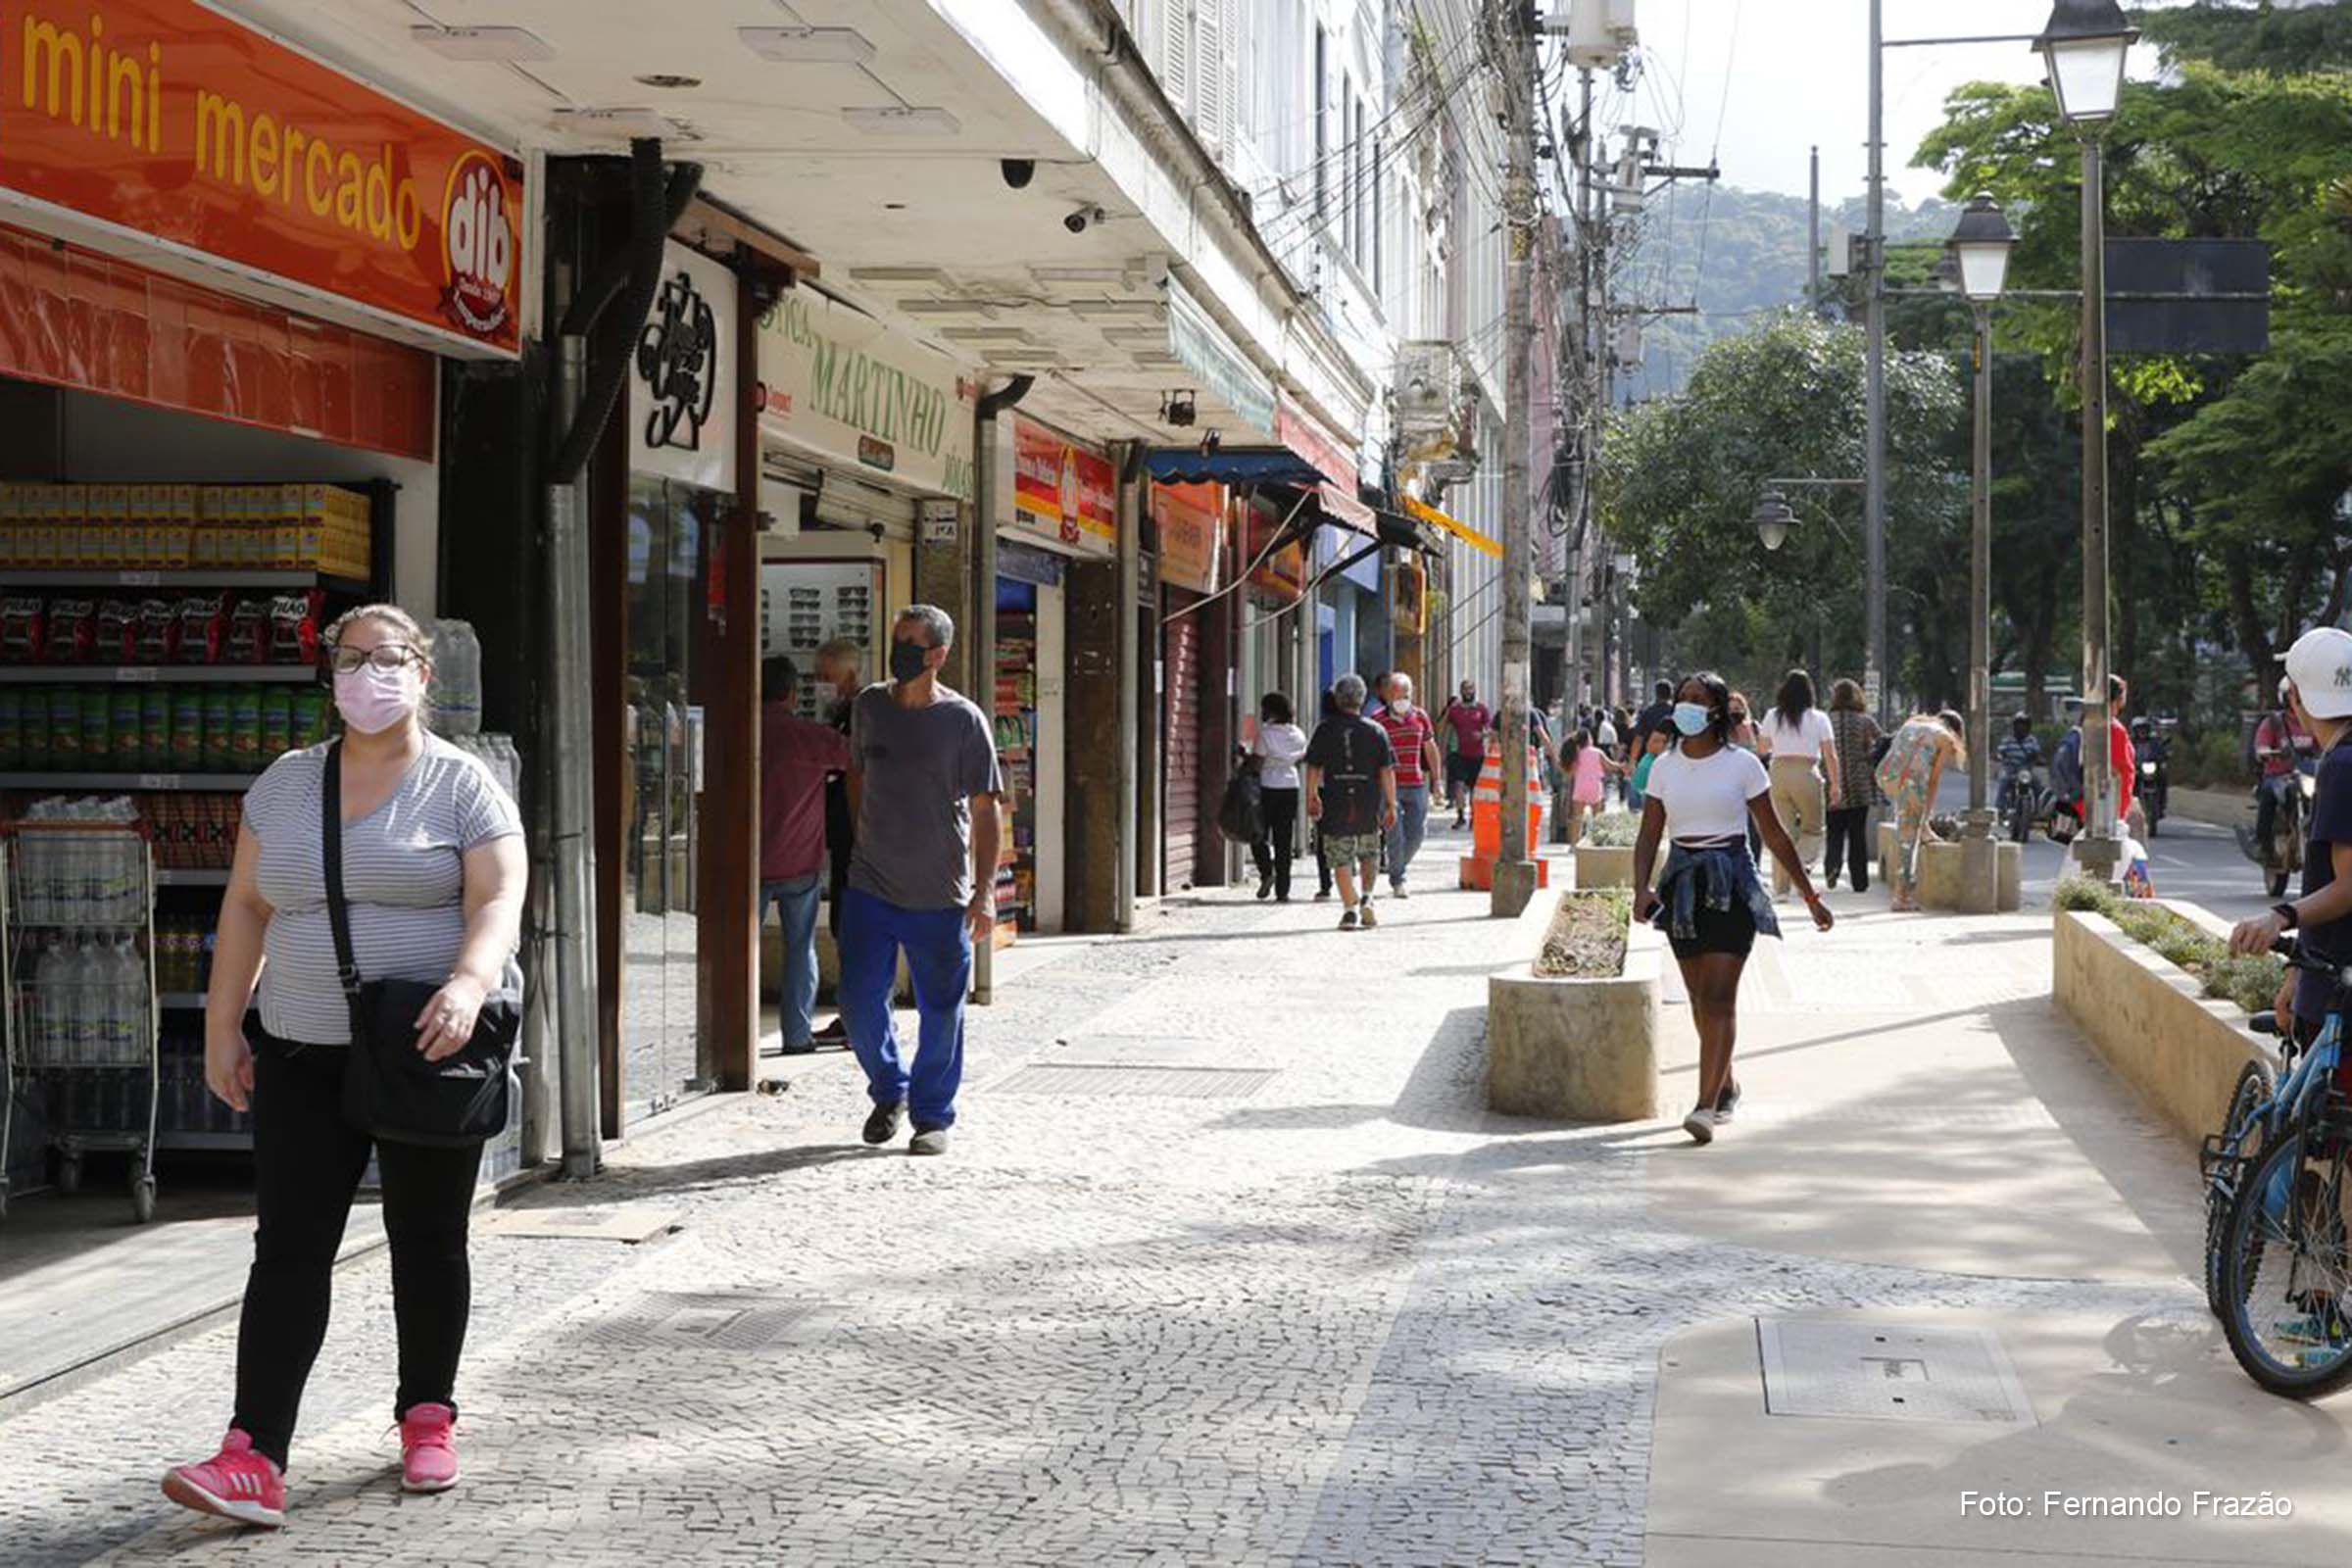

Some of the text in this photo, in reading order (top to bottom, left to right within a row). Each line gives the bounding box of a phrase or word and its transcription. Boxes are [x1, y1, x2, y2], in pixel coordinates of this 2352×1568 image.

[22, 12, 422, 252] mini mercado
[448, 166, 512, 291] dib
[808, 330, 948, 459] MARTINHO
